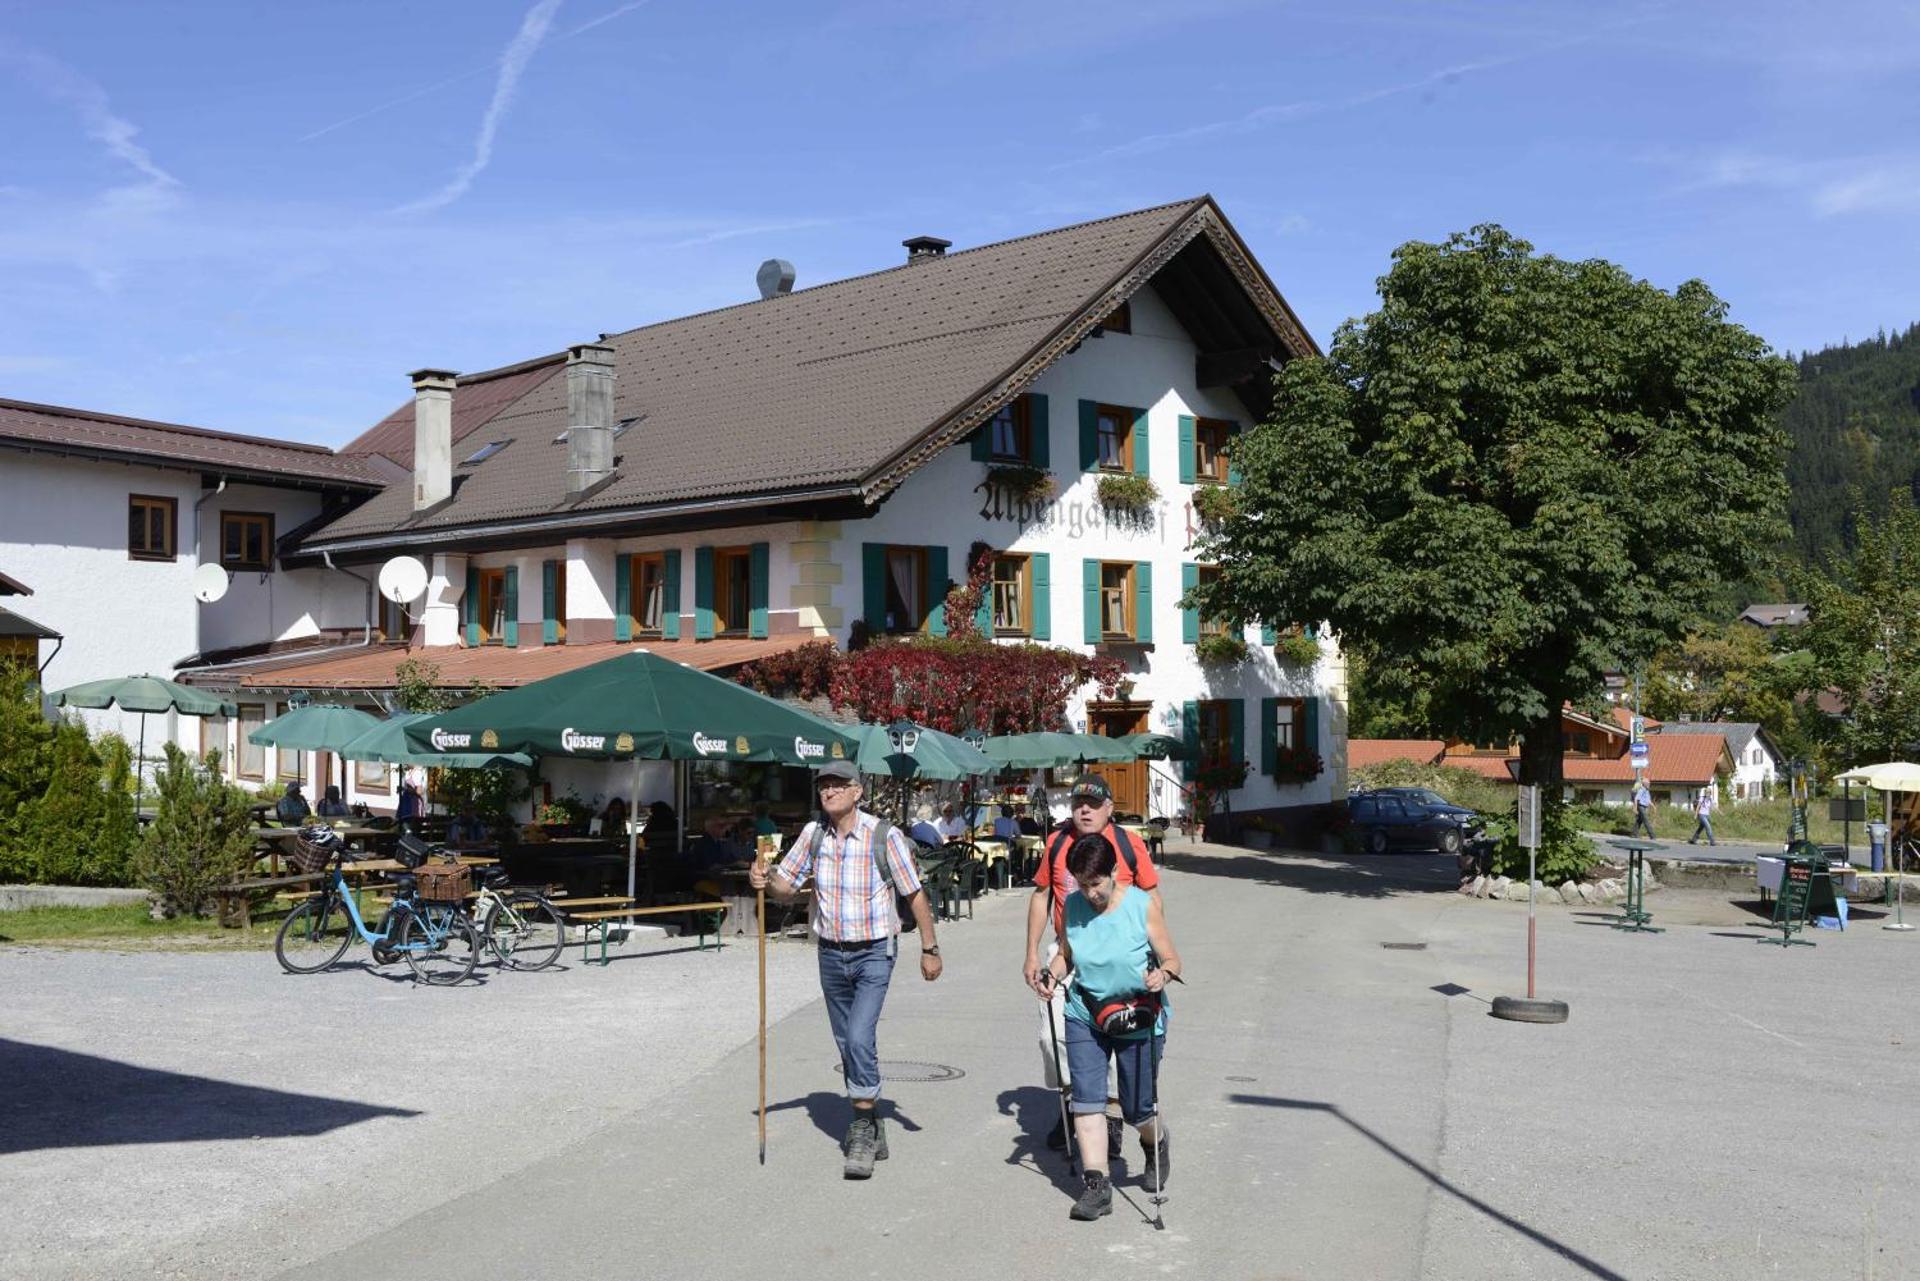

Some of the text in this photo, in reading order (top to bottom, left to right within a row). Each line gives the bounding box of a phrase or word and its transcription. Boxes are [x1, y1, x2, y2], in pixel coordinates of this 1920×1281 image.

[431, 727, 472, 752] Gösser
[561, 727, 606, 753] Gösser
[692, 731, 728, 757] Gösser
[794, 736, 825, 760] Gösser
